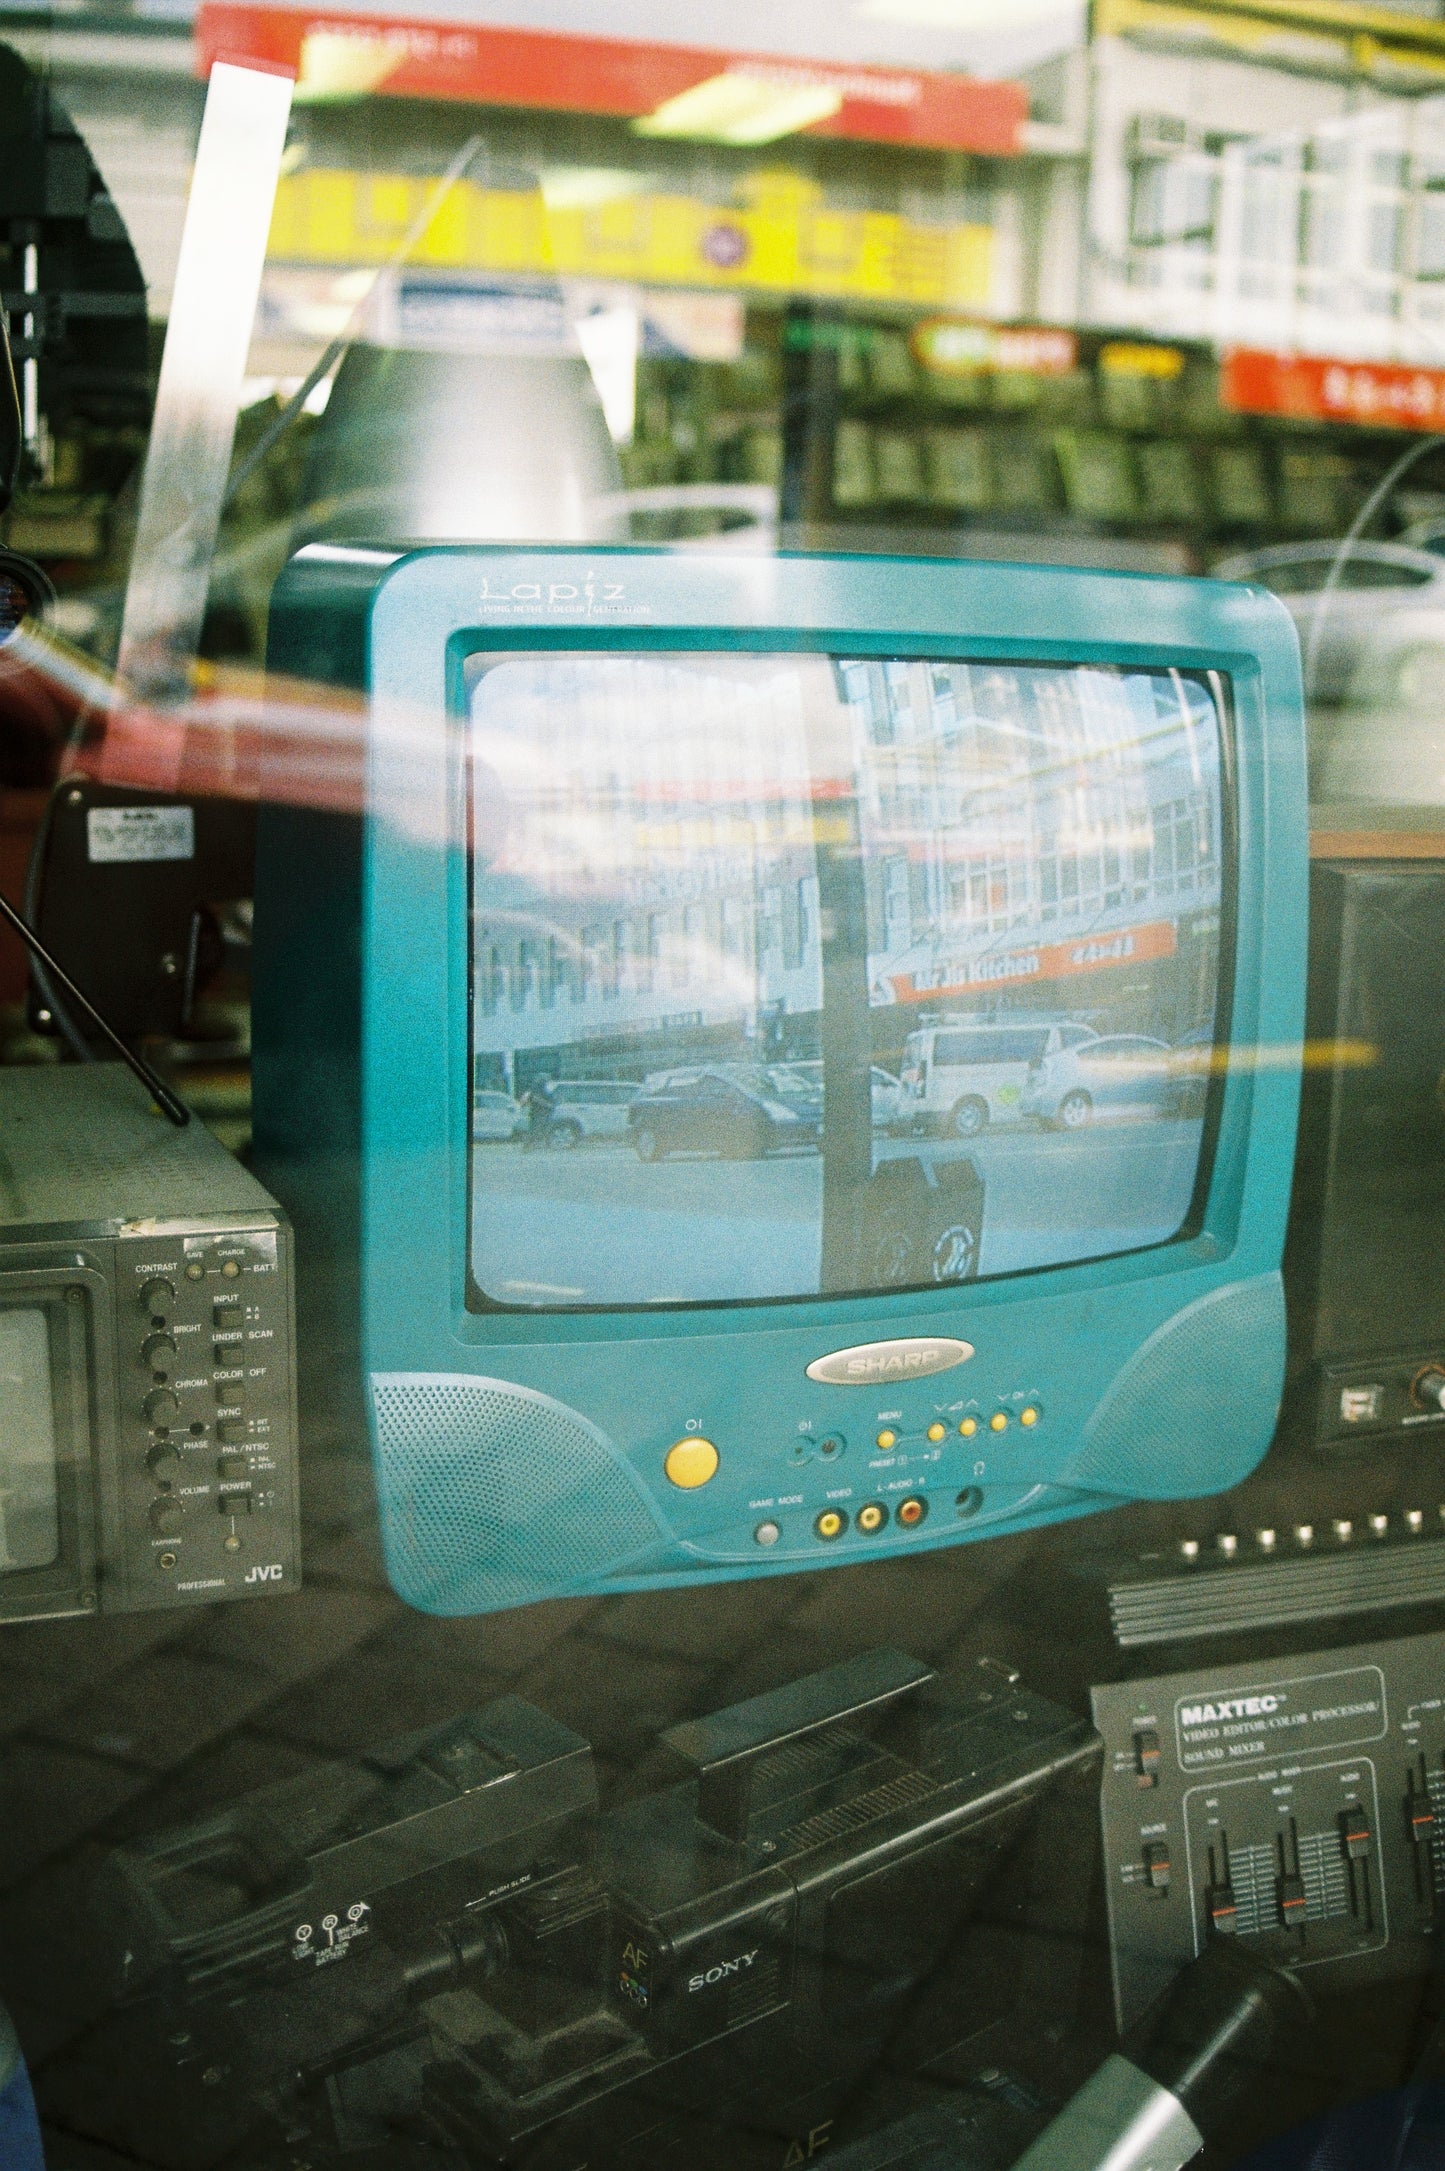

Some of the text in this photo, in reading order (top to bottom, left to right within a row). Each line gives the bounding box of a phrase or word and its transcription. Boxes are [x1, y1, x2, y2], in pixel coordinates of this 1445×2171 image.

[480, 571, 626, 617] Lapiz
[135, 1262, 178, 1273] CONTRAST
[213, 1293, 239, 1304] INPUT
[173, 1323, 202, 1335] BRIGHT
[212, 1329, 274, 1342] UNDER SCAN
[847, 1350, 939, 1374] SHARP
[213, 1367, 267, 1380] COLOR OFF
[175, 1379, 209, 1389] CHROMA
[217, 1407, 241, 1418] SYNC
[877, 1411, 902, 1421] MENU
[183, 1440, 208, 1450] PHASE
[180, 1485, 210, 1496] VOLUME
[220, 1481, 252, 1492] POWER
[826, 1488, 852, 1499] VIDEO
[749, 1495, 804, 1508] GAME MODE
[244, 1564, 283, 1583] JVC
[177, 1579, 226, 1591] PROFESSIONAL
[1181, 1695, 1279, 1726] MAXTEC
[623, 1942, 648, 1969] AF
[688, 1949, 759, 1993] SONY
[782, 2119, 834, 2170] AF
